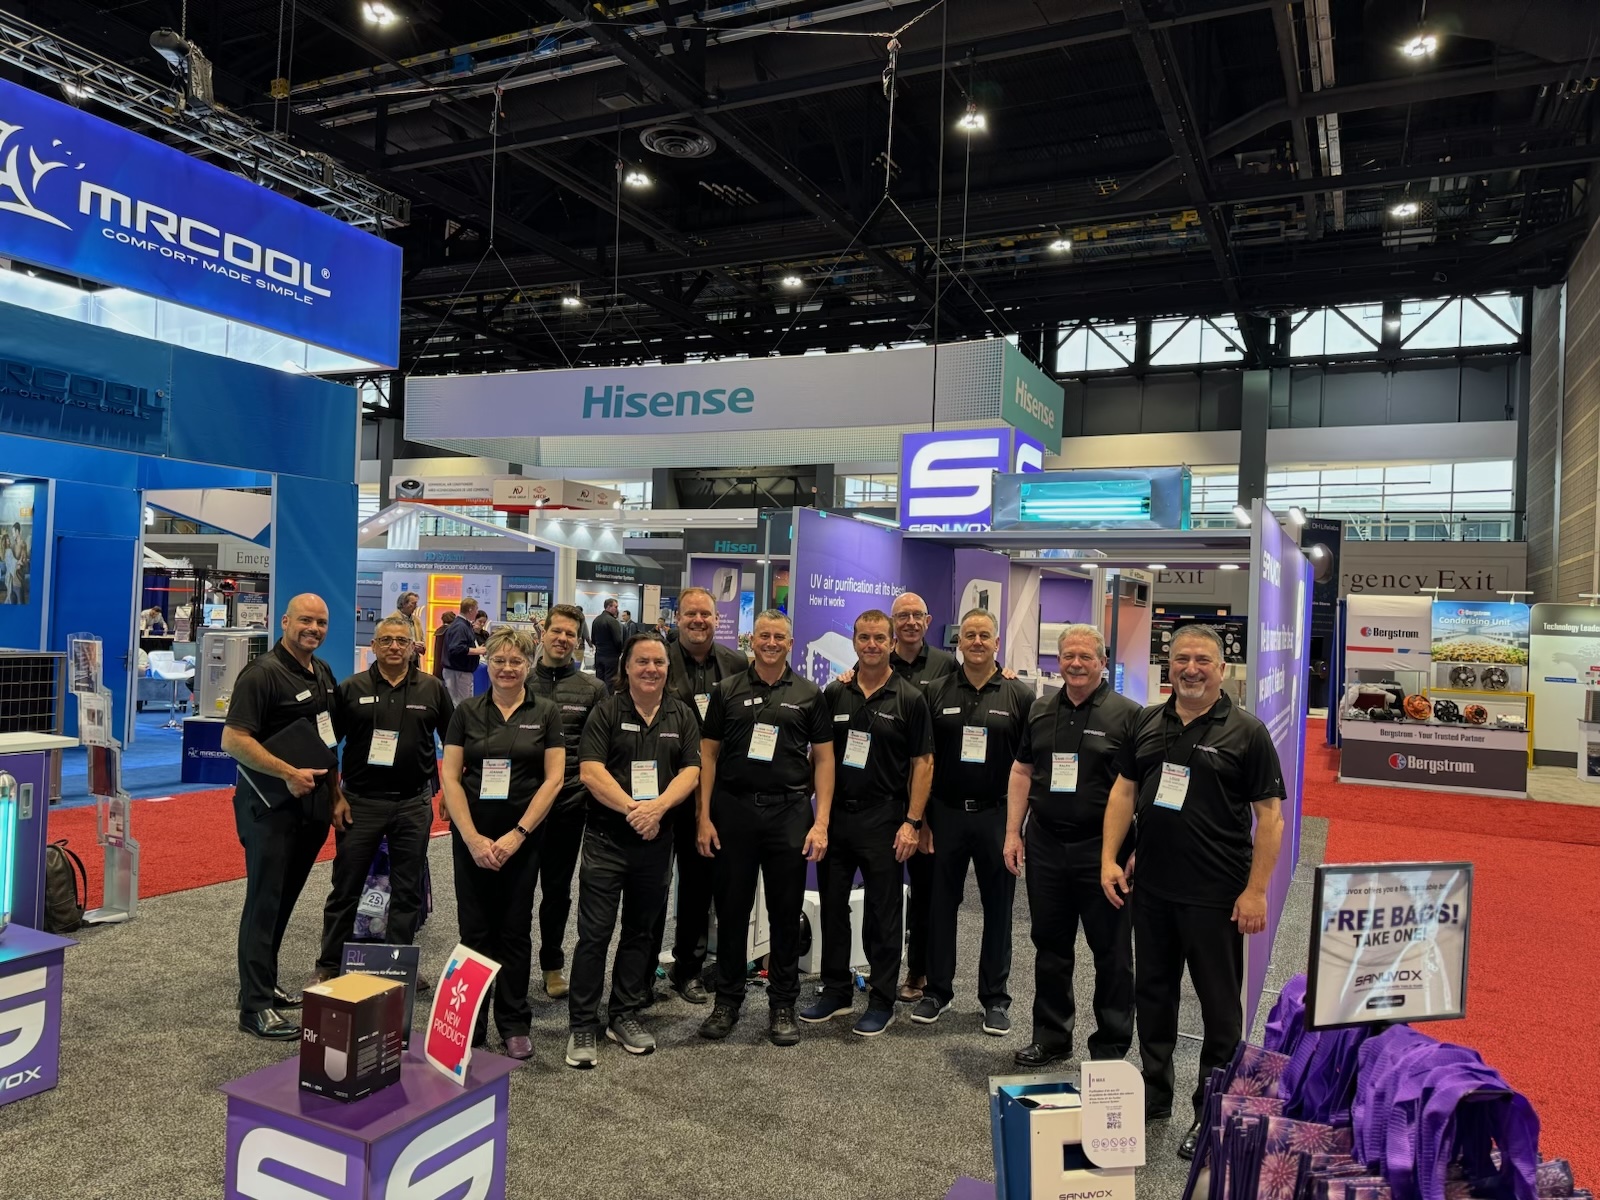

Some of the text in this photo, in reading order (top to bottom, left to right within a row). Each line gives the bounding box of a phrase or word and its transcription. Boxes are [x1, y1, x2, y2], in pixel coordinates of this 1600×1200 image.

[102, 228, 313, 305] COMFORT MADE SIMPLE
[0, 358, 165, 412] RCOOL
[582, 385, 755, 419] Hisense
[1015, 377, 1055, 429] Hisense
[236, 551, 270, 568] Emerg
[810, 573, 822, 589] UV
[823, 575, 833, 589] air
[835, 577, 874, 594] purification
[875, 582, 881, 595] at
[882, 582, 890, 596] its
[1157, 569, 1204, 585] Exit
[1436, 570, 1495, 590] Exit
[809, 594, 845, 607] How it works
[1439, 616, 1511, 626] Condensing Unit
[1543, 622, 1579, 633] Technology
[1373, 627, 1419, 640] Bergstrom
[1380, 728, 1413, 739] Bergstrom
[1418, 731, 1433, 740] Your
[1434, 732, 1459, 742] Trusted
[1460, 733, 1485, 743] Partner
[1408, 755, 1475, 775] Bergstrom
[368, 895, 380, 904] 25
[1324, 908, 1385, 932] FREE
[1353, 927, 1427, 948] TAKE ONE!
[1355, 969, 1422, 987] SANUVOX
[443, 1008, 461, 1026] NEW
[433, 1018, 466, 1047] PRODUCT
[1059, 1189, 1113, 1200] SANUVOX
